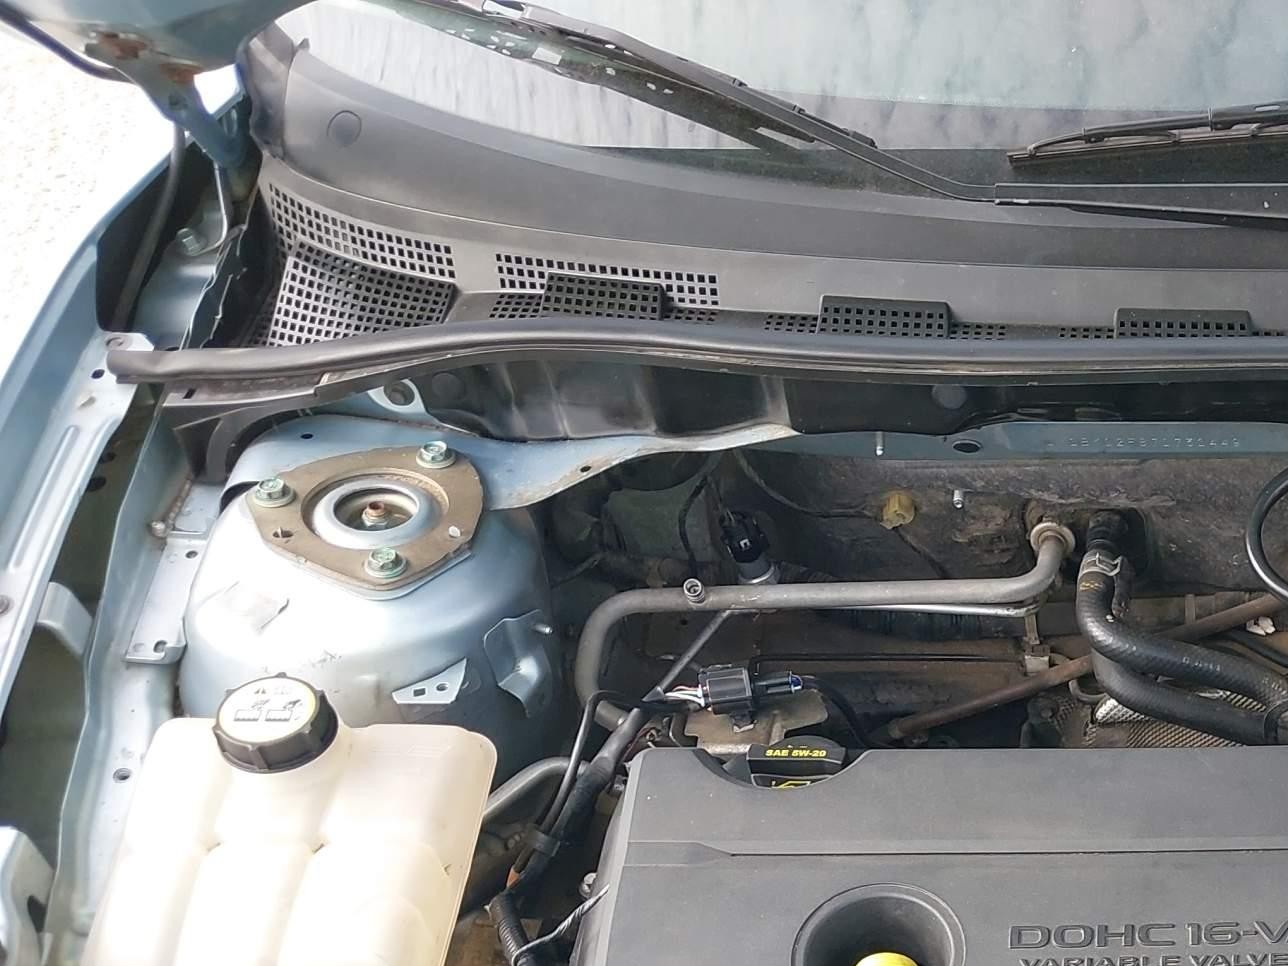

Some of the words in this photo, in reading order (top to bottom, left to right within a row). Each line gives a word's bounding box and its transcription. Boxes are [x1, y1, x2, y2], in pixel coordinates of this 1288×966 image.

[765, 749, 789, 757] SAE
[791, 749, 827, 758] 5W-20
[1008, 922, 1177, 949] DOHC
